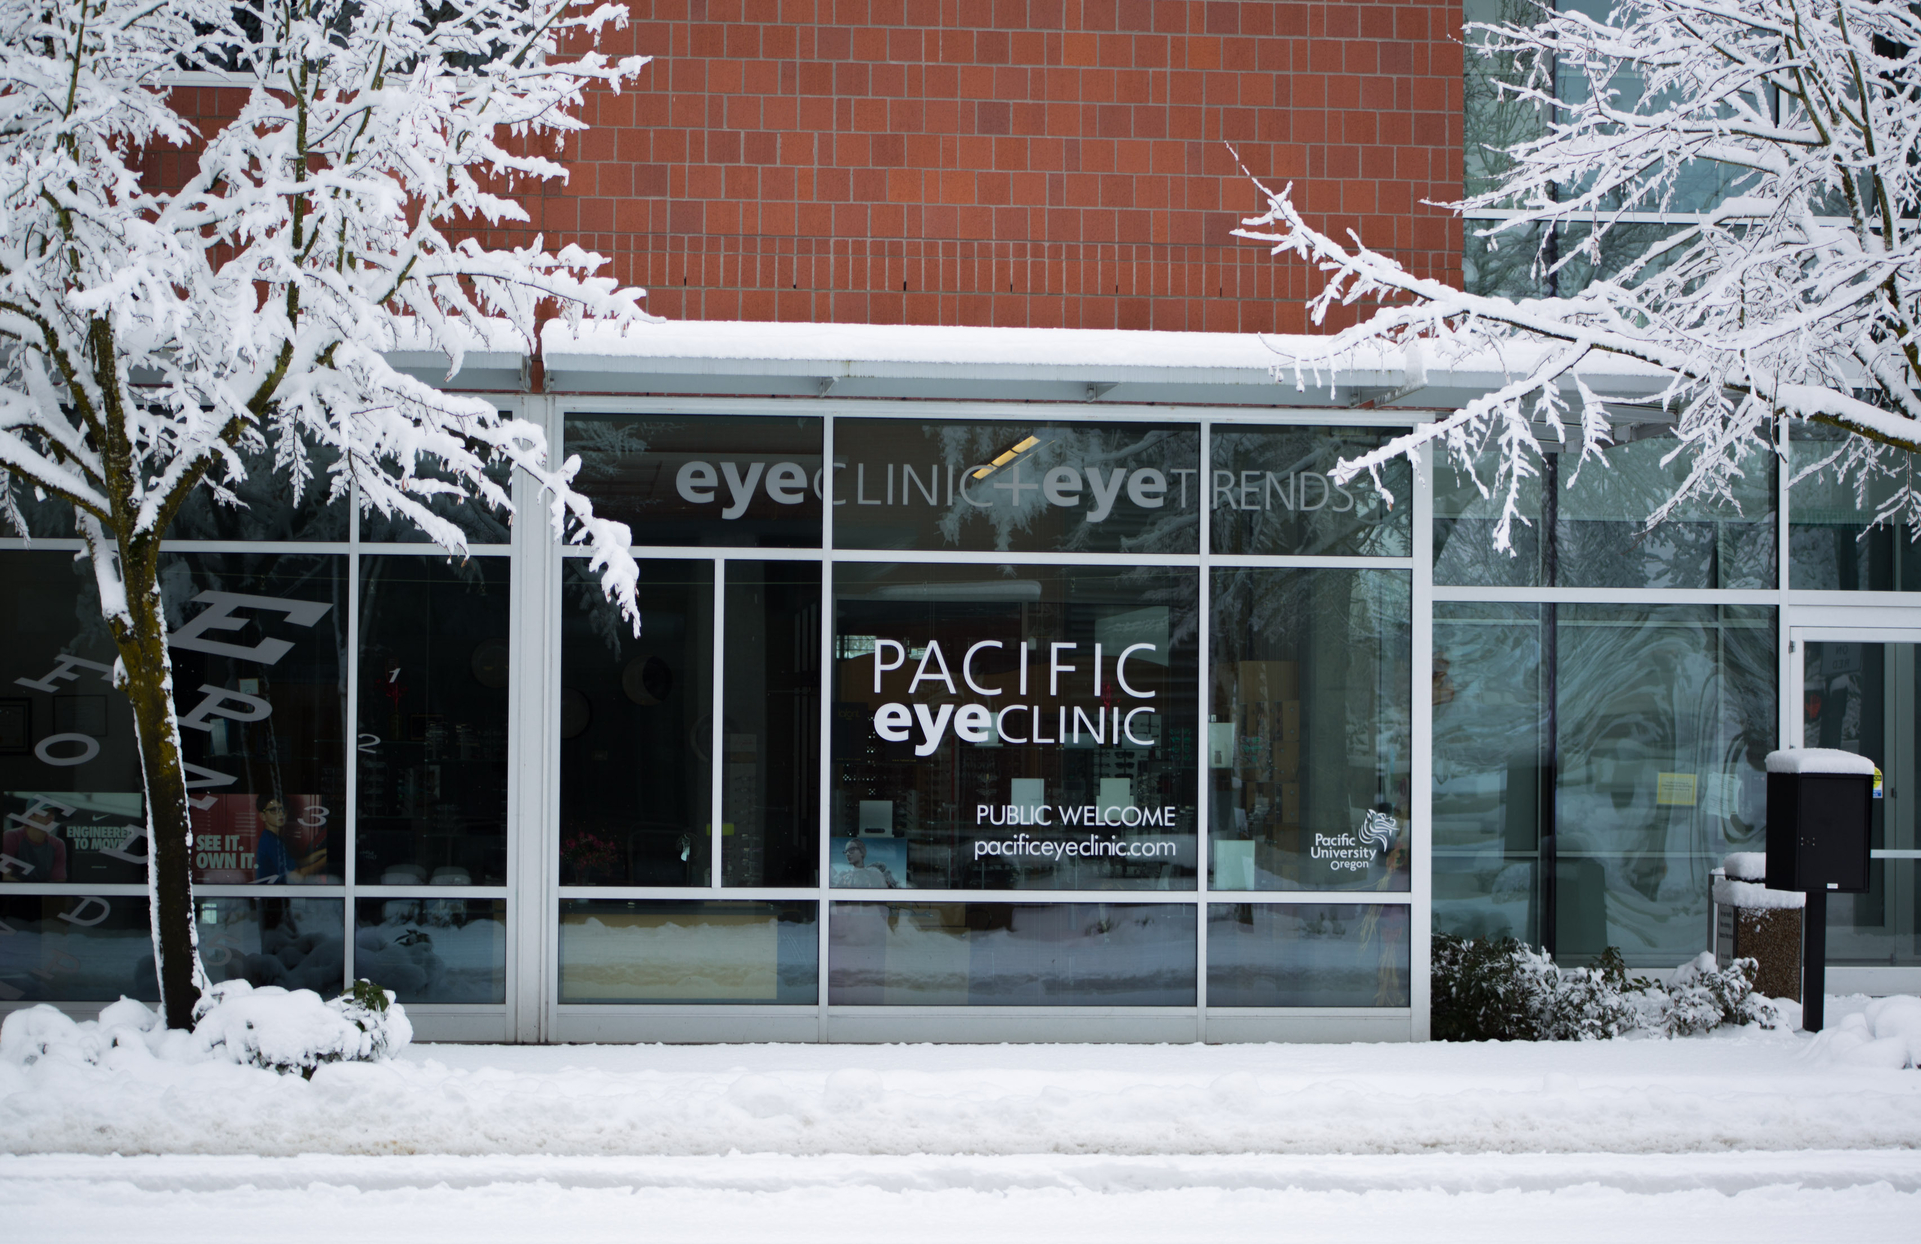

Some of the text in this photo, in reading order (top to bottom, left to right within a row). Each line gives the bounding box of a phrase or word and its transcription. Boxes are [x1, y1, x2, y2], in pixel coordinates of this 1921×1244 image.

[168, 589, 402, 683] E 1
[873, 639, 1157, 698] PACIFIC
[178, 684, 273, 732] P
[357, 733, 381, 754] 2
[873, 702, 1156, 757] eyeCLINIC
[34, 732, 100, 766] O
[297, 805, 330, 827] 3
[6, 794, 77, 833] E
[976, 804, 1176, 827] PUBLIC WELCOME
[74, 838, 89, 850] TO
[196, 835, 244, 851] SEE IT.
[974, 833, 1177, 861] pacificeyeclinic.com
[1315, 832, 1356, 846] Pacific
[196, 852, 259, 869] OWN IT.
[1310, 846, 1377, 861] University
[1330, 860, 1370, 872] Oregon
[57, 895, 111, 926] D
